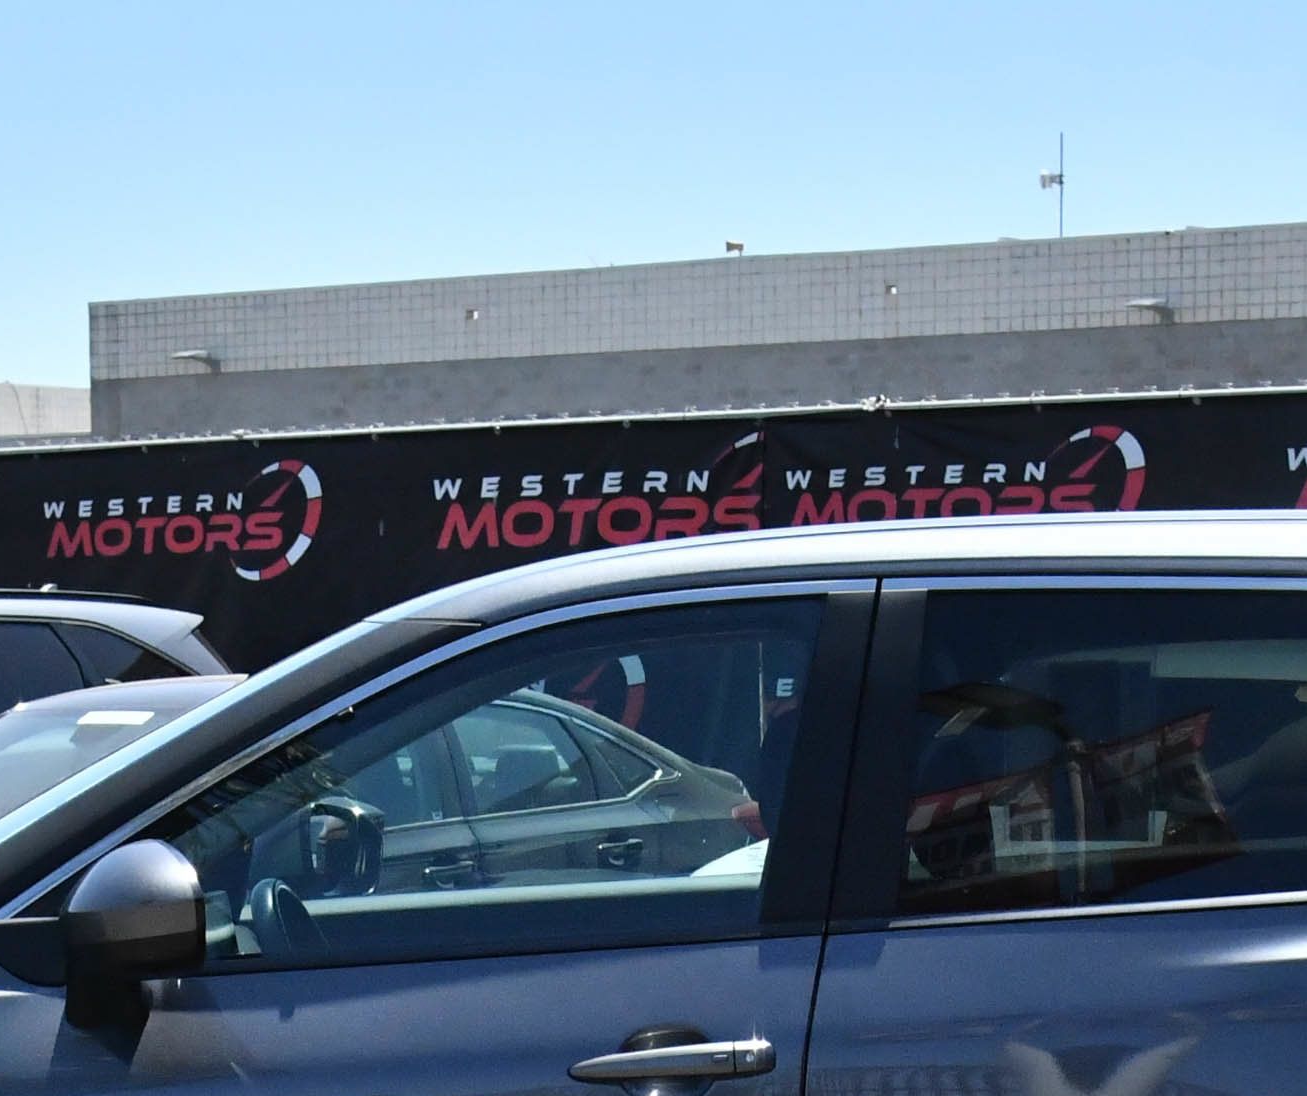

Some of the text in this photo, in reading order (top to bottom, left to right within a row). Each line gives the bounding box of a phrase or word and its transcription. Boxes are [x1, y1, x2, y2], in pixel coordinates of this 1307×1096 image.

[433, 470, 709, 501] WESTERN
[786, 461, 1046, 490] WESTERN
[43, 492, 243, 519] WESTERN
[47, 511, 283, 558] MOTORS
[437, 494, 760, 549] MOTORS
